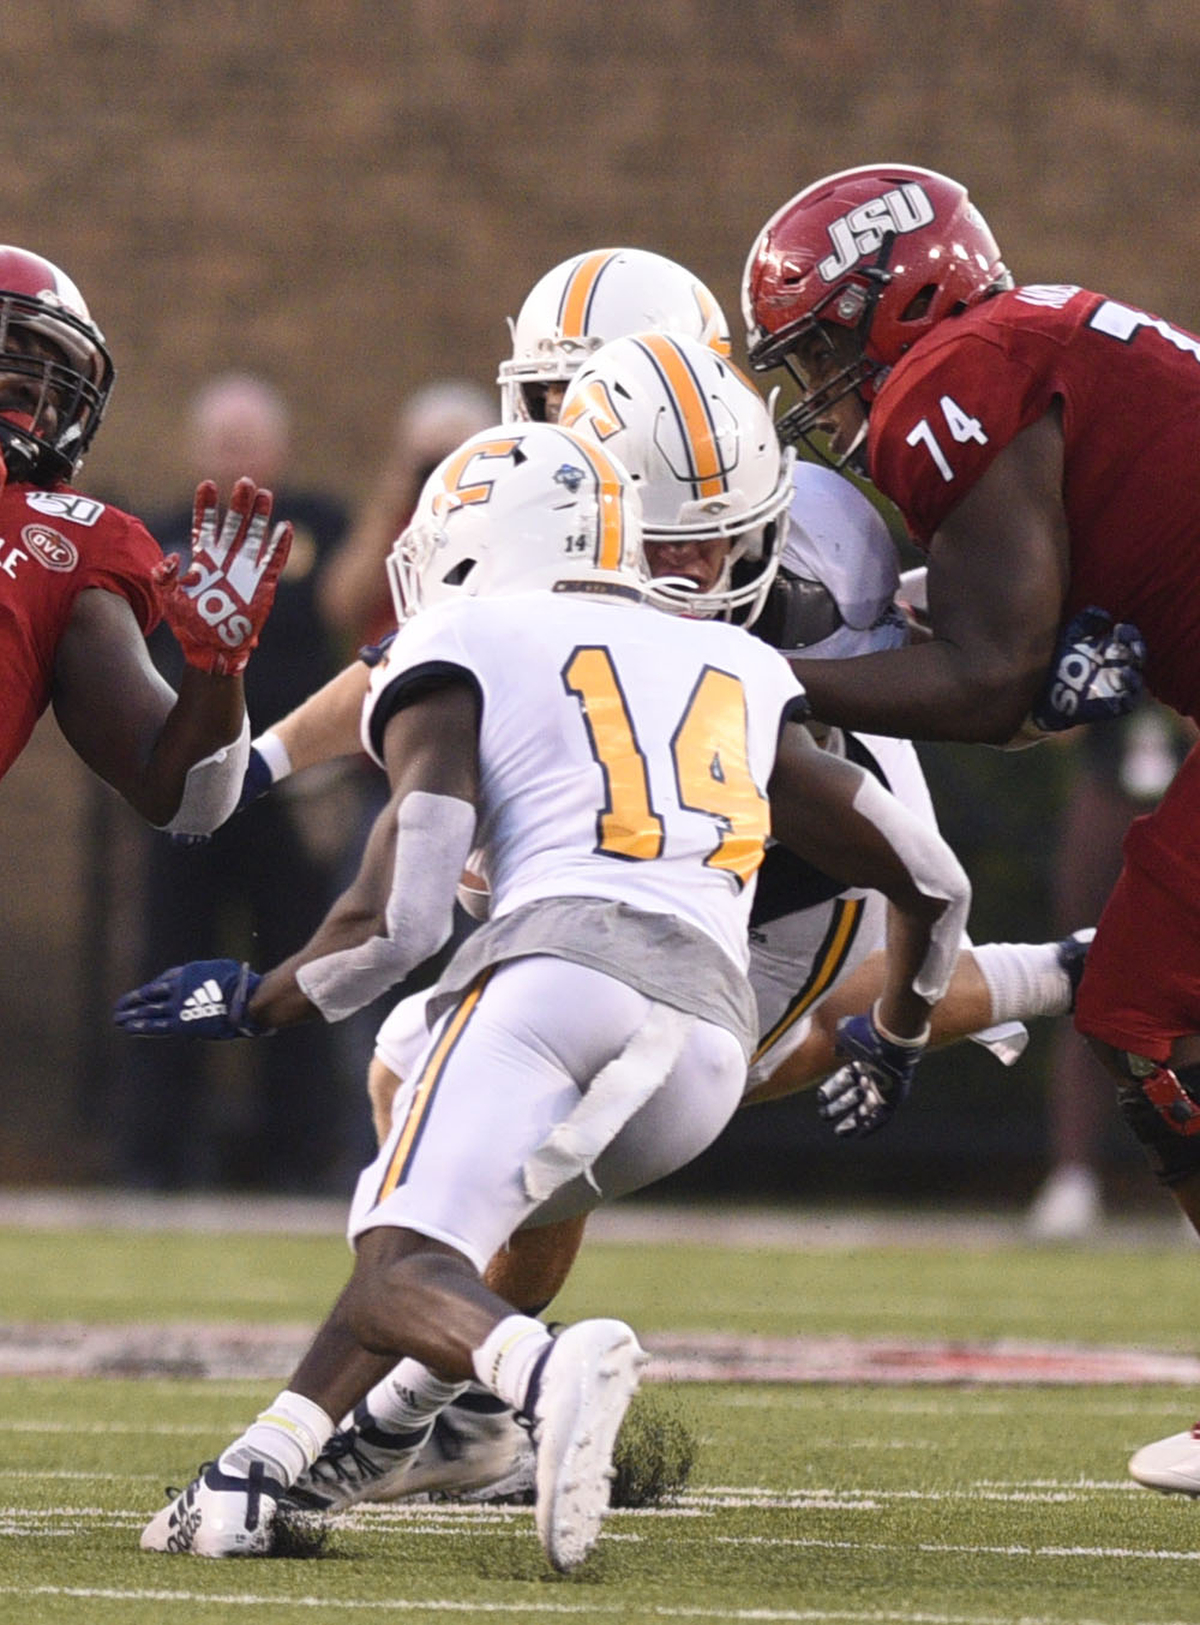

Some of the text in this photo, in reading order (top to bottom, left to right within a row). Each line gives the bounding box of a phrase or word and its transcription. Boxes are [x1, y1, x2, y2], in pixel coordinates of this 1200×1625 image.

[816, 182, 936, 283] JSU
[432, 436, 525, 515] C
[906, 395, 989, 482] 74
[32, 534, 67, 562] OVC
[564, 534, 587, 553] 14
[561, 645, 771, 893] 14
